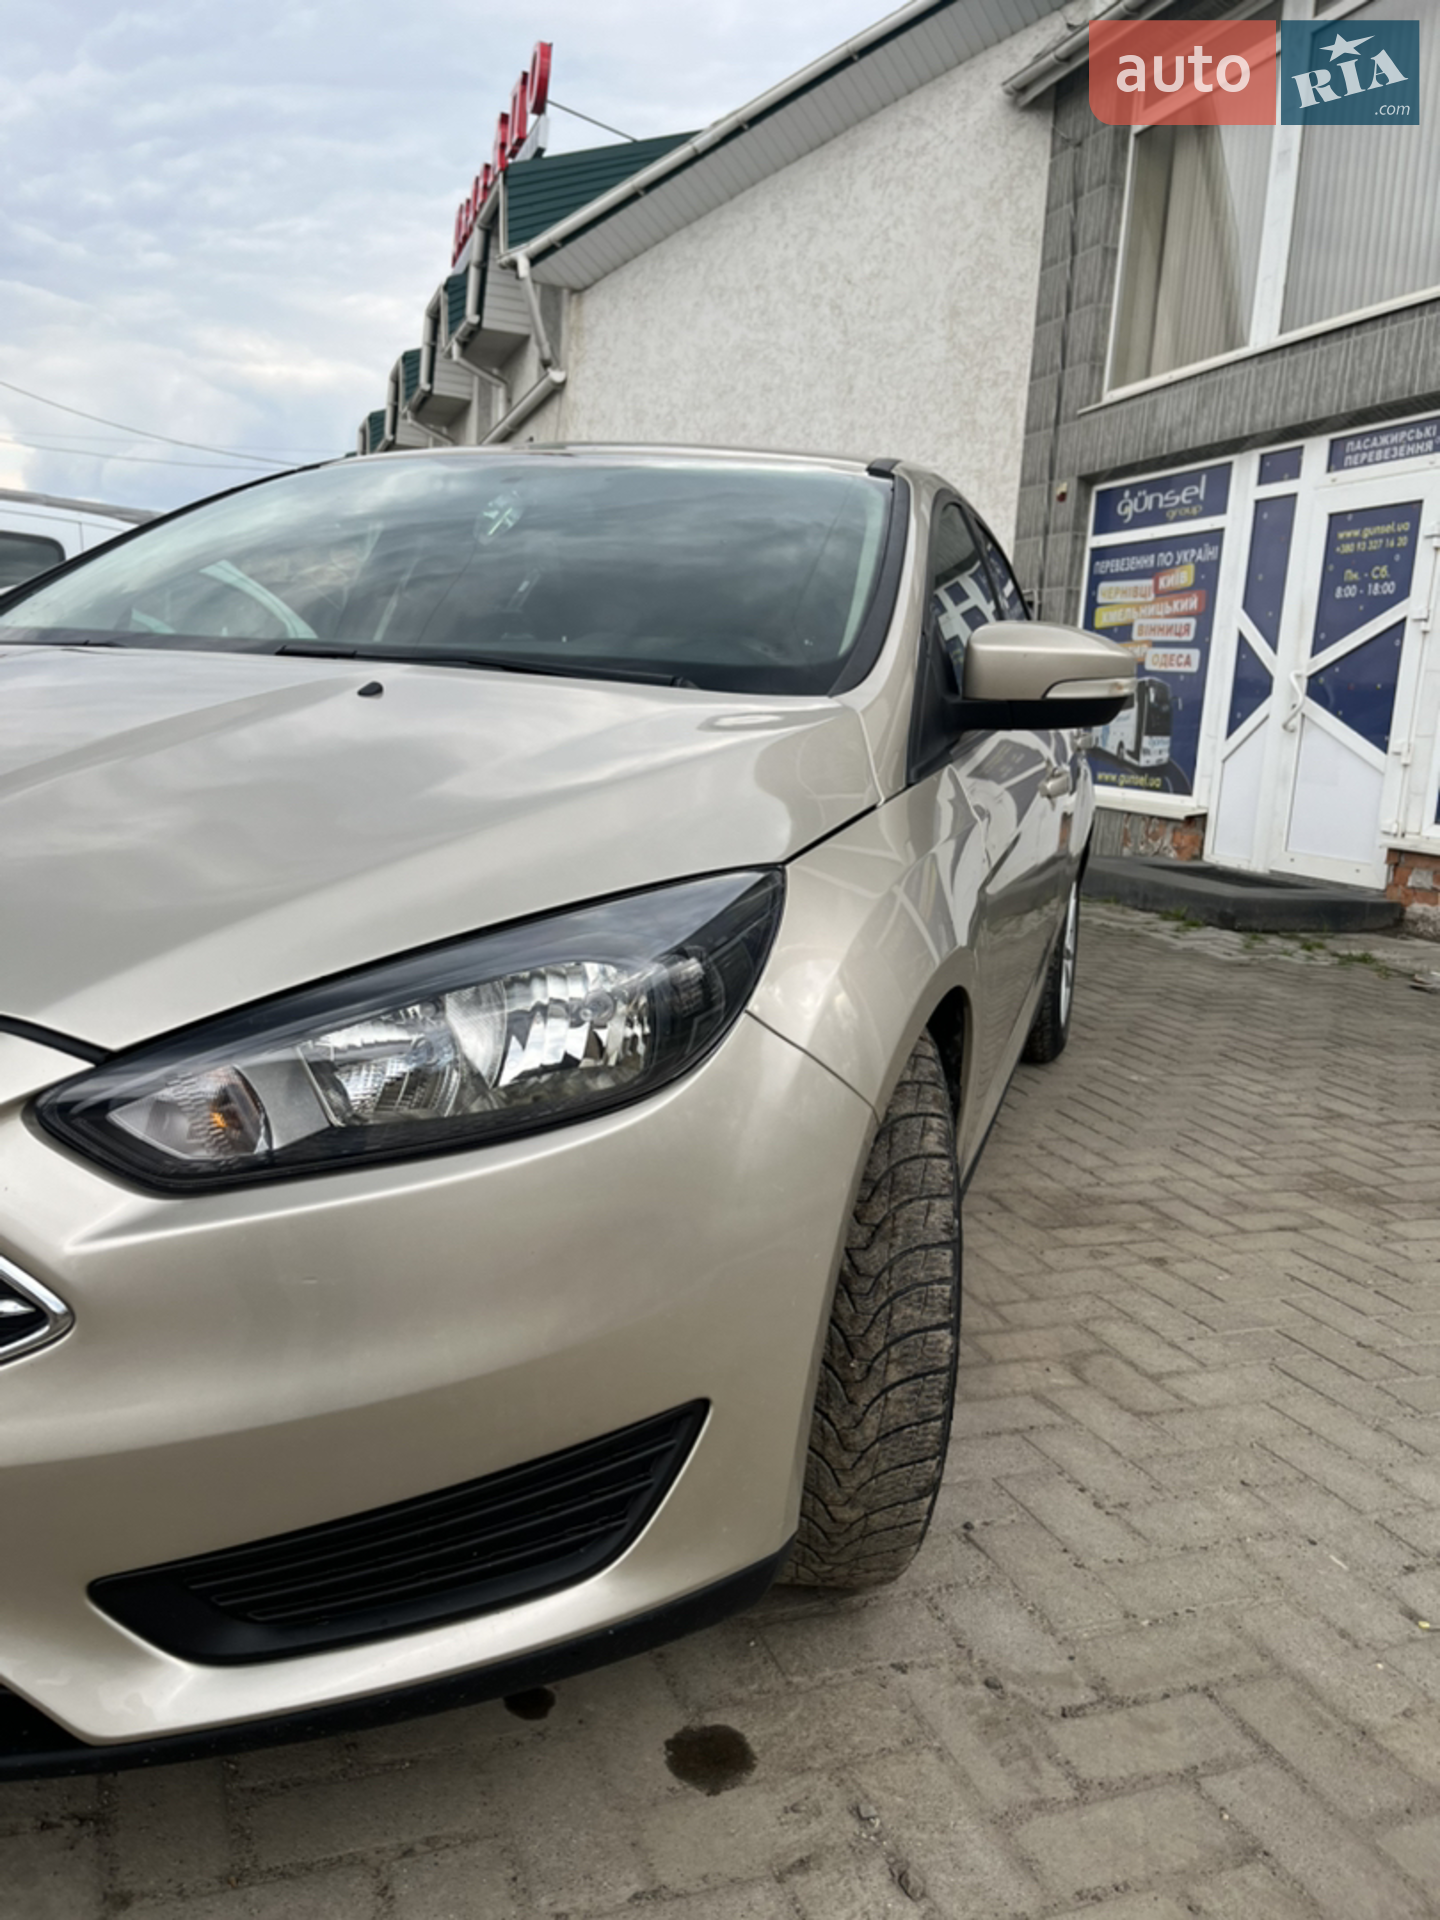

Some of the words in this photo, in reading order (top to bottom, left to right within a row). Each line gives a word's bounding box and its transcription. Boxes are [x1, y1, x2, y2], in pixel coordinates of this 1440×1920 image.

[1345, 424, 1437, 454] ПАСАЖИРСЬКІ
[1343, 440, 1434, 467] ПЕРЕВЕЗЕННЯ
[1336, 521, 1411, 540] www.gunsel.ua
[1093, 554, 1155, 575] ПЕРЕВЕЗЕННЯ
[1156, 551, 1175, 567] ПО
[1174, 543, 1219, 564] УКРАЇНІ
[1158, 569, 1189, 591] КИЇВ
[1334, 584, 1358, 599] 8:00
[1367, 581, 1396, 597] 18:00
[1136, 622, 1192, 639] ВІННИЦЯ
[1151, 653, 1193, 669] ОДЕСА
